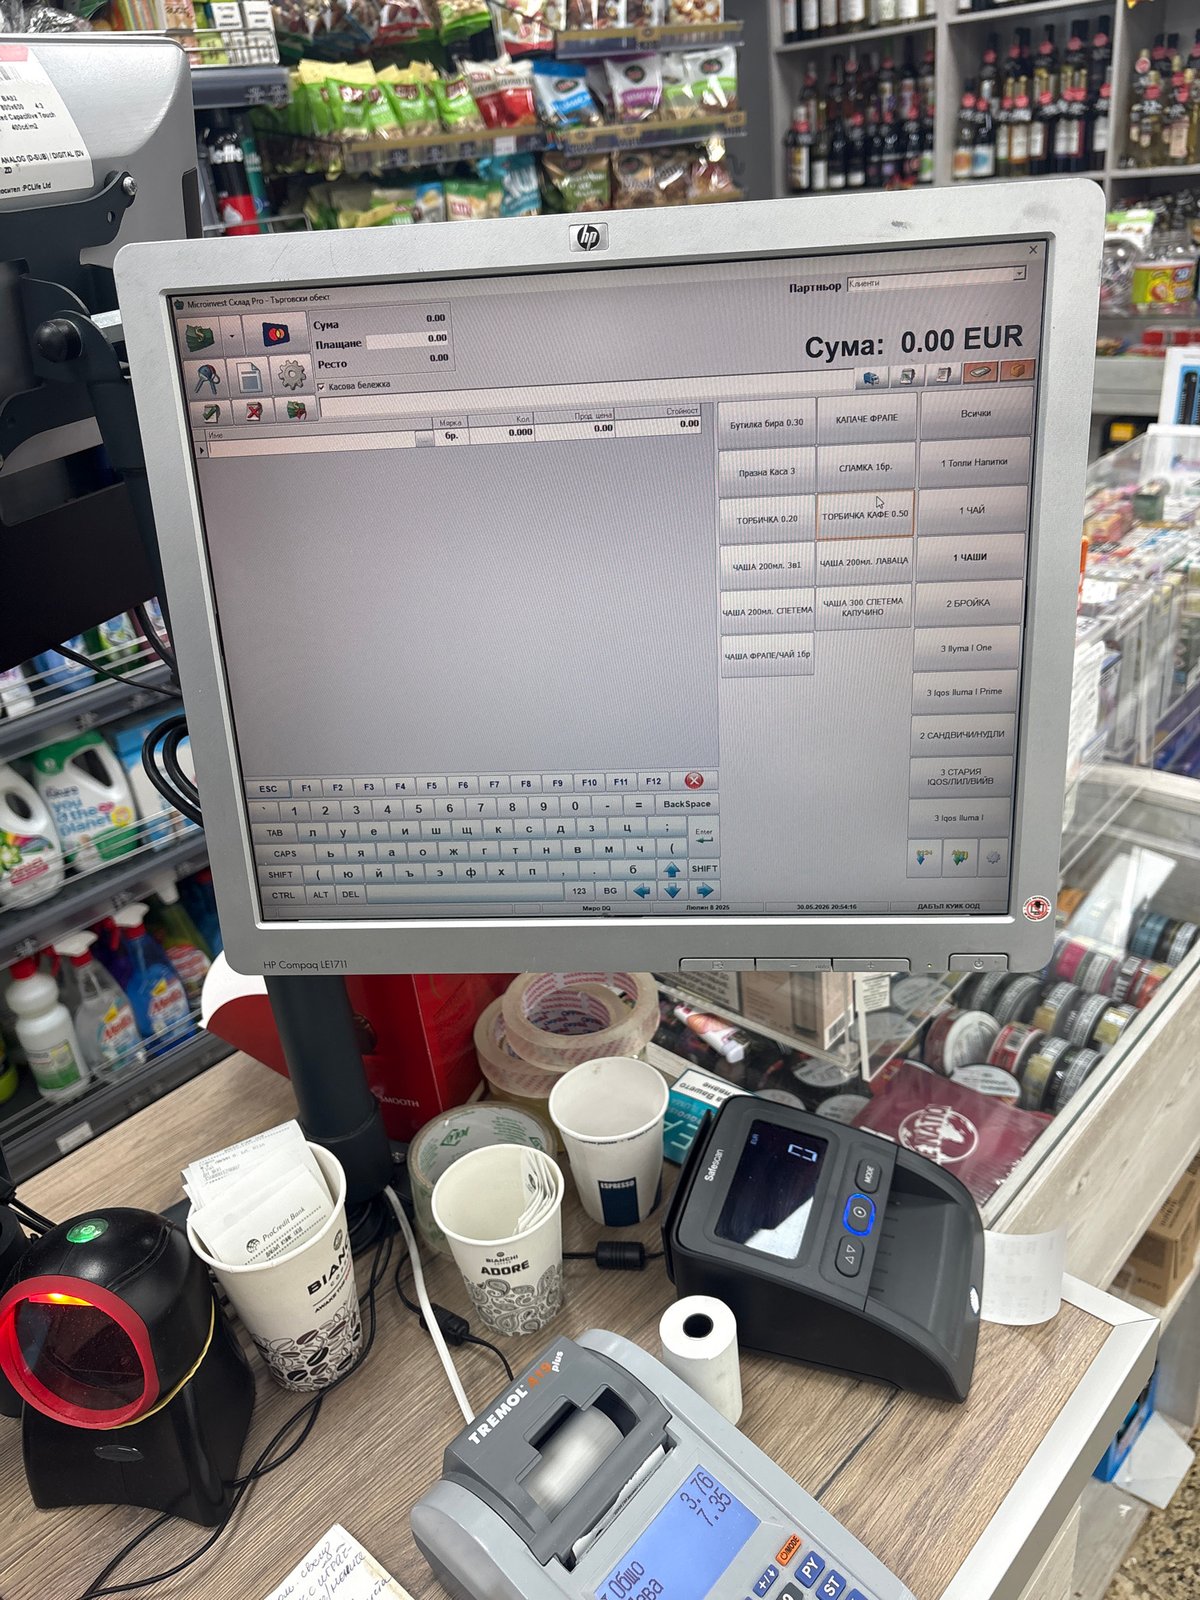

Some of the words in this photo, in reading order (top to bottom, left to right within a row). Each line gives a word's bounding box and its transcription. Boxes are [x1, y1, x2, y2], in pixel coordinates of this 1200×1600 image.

[1, 155, 26, 164] ANALOG
[27, 153, 49, 162] (D-SUB)
[580, 225, 599, 250] hp
[789, 282, 842, 295] Партньор
[849, 279, 880, 288] Клиенти
[187, 298, 228, 308] Microinvest
[229, 298, 250, 306] Склад
[251, 297, 264, 305] Pro
[270, 295, 308, 304] Търговски
[309, 294, 330, 302] обект
[313, 320, 339, 330] Сума
[426, 314, 446, 323] 0.00
[315, 339, 362, 350] Плащане
[428, 334, 447, 343] 0.00
[805, 336, 884, 364] Сума:
[901, 328, 955, 354] 0.00
[964, 324, 1024, 350] EUR
[318, 360, 348, 370] Ресто
[430, 354, 449, 362] 0.00
[329, 382, 355, 391] Касова
[357, 380, 391, 390] бележка
[667, 407, 698, 416] Стойност
[961, 409, 992, 418] Всички
[730, 420, 762, 430] Бутилка
[764, 420, 784, 429] бира
[786, 418, 804, 426] 0.30
[836, 415, 868, 424] КАПАЧЕ
[870, 414, 898, 422] ФРАПЕ
[445, 431, 458, 441] бр.
[509, 428, 533, 437] 0.000
[594, 424, 613, 433] 0.00
[680, 419, 700, 428] 0.00
[839, 464, 874, 472] СЛАМКА
[948, 459, 972, 468] Топли
[974, 458, 1008, 466] Напитки
[739, 468, 768, 478] Празна
[770, 468, 788, 476] Каса
[790, 467, 796, 475] 3
[966, 504, 986, 514] ЧАЙ
[737, 516, 779, 525] ТОРБИЧКА
[781, 514, 798, 523] 0.20
[822, 512, 865, 521] ТОРБИЧКА
[867, 510, 890, 519] КАФЕ
[891, 510, 909, 518] 0.50
[820, 558, 844, 567] ЧАША
[846, 558, 873, 566] 200мл.
[876, 556, 909, 566] ЛАВАЦА
[960, 553, 988, 562] ЧАШИ
[733, 562, 756, 572] ЧАША
[758, 562, 785, 571] 200мл.
[824, 599, 847, 608] ЧАША
[850, 598, 864, 606] 300
[866, 598, 904, 606] СПЕТЕМА
[954, 598, 991, 608] БРОЙКА
[722, 608, 746, 617] ЧАША
[748, 608, 774, 616] 200мл.
[776, 606, 814, 615] СПЕТЕМА
[842, 608, 884, 618] КАПУЧИНО
[976, 644, 992, 652] One
[725, 652, 748, 660] ЧАША
[750, 650, 795, 660] ФРАПЕ/ЧАЙ
[927, 730, 1005, 740] САНДВИЧИ/НУДЛИ
[948, 768, 982, 776] СТАРИЯ
[582, 778, 597, 786] F10
[260, 785, 278, 793] ESC
[302, 784, 312, 792] F1
[266, 829, 284, 837] TAB
[274, 850, 296, 858] CAPS
[268, 871, 293, 879] SHIFT
[272, 891, 296, 899] CTRL
[342, 890, 360, 898] DEL
[264, 961, 276, 969] HP
[278, 960, 319, 971] Compaq
[320, 960, 348, 968] LE1711
[704, 1148, 725, 1182] Safescan
[864, 1164, 875, 1184] MODE
[600, 1180, 635, 1189] ESPRESSO
[262, 1218, 291, 1242] ProCredit
[290, 1206, 306, 1222] Bank
[486, 1254, 519, 1263] BIANCHI
[480, 1260, 530, 1276] ADORE
[468, 1385, 528, 1445] TREMOL
[552, 1350, 564, 1372] plus
[696, 1488, 732, 1527] 7.35
[802, 1556, 819, 1579] PY
[608, 1560, 645, 1598] Общо
[626, 1578, 664, 1600] ева
[824, 1576, 840, 1597] ST
